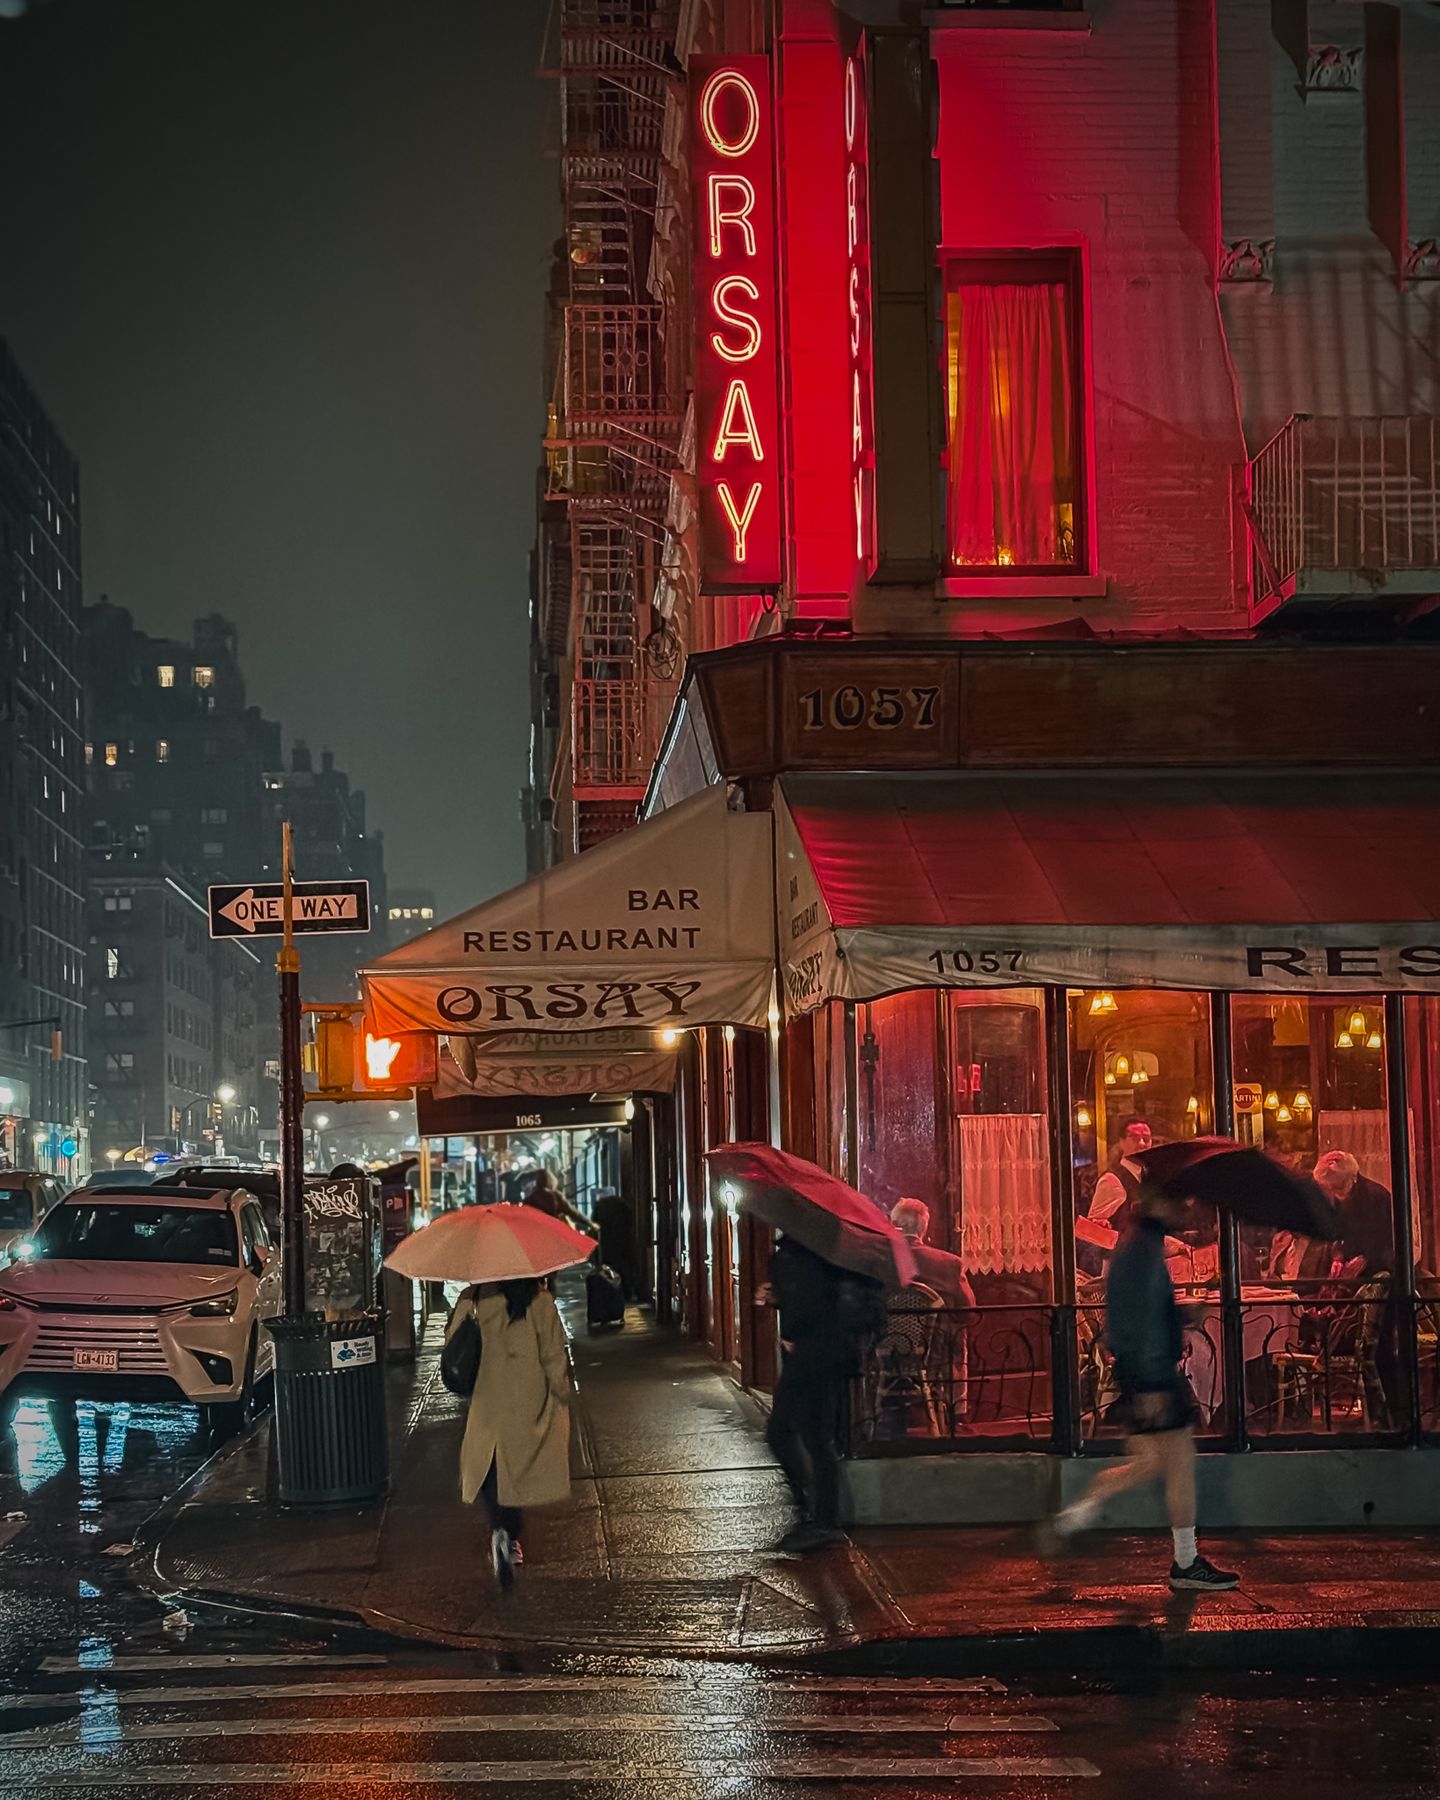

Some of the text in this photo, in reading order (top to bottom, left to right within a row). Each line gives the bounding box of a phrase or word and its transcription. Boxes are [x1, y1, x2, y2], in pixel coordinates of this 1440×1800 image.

[701, 68, 762, 563] ORSAY
[800, 685, 940, 730] 1057
[235, 897, 348, 920] ONE WAY
[628, 889, 700, 911] BAR
[463, 927, 701, 952] RESTAURANT
[928, 950, 1023, 974] 1057
[1246, 945, 1440, 977] RES
[436, 981, 701, 1022] ORSAY
[1234, 1094, 1262, 1103] ARTINI
[515, 1114, 542, 1127] 1065
